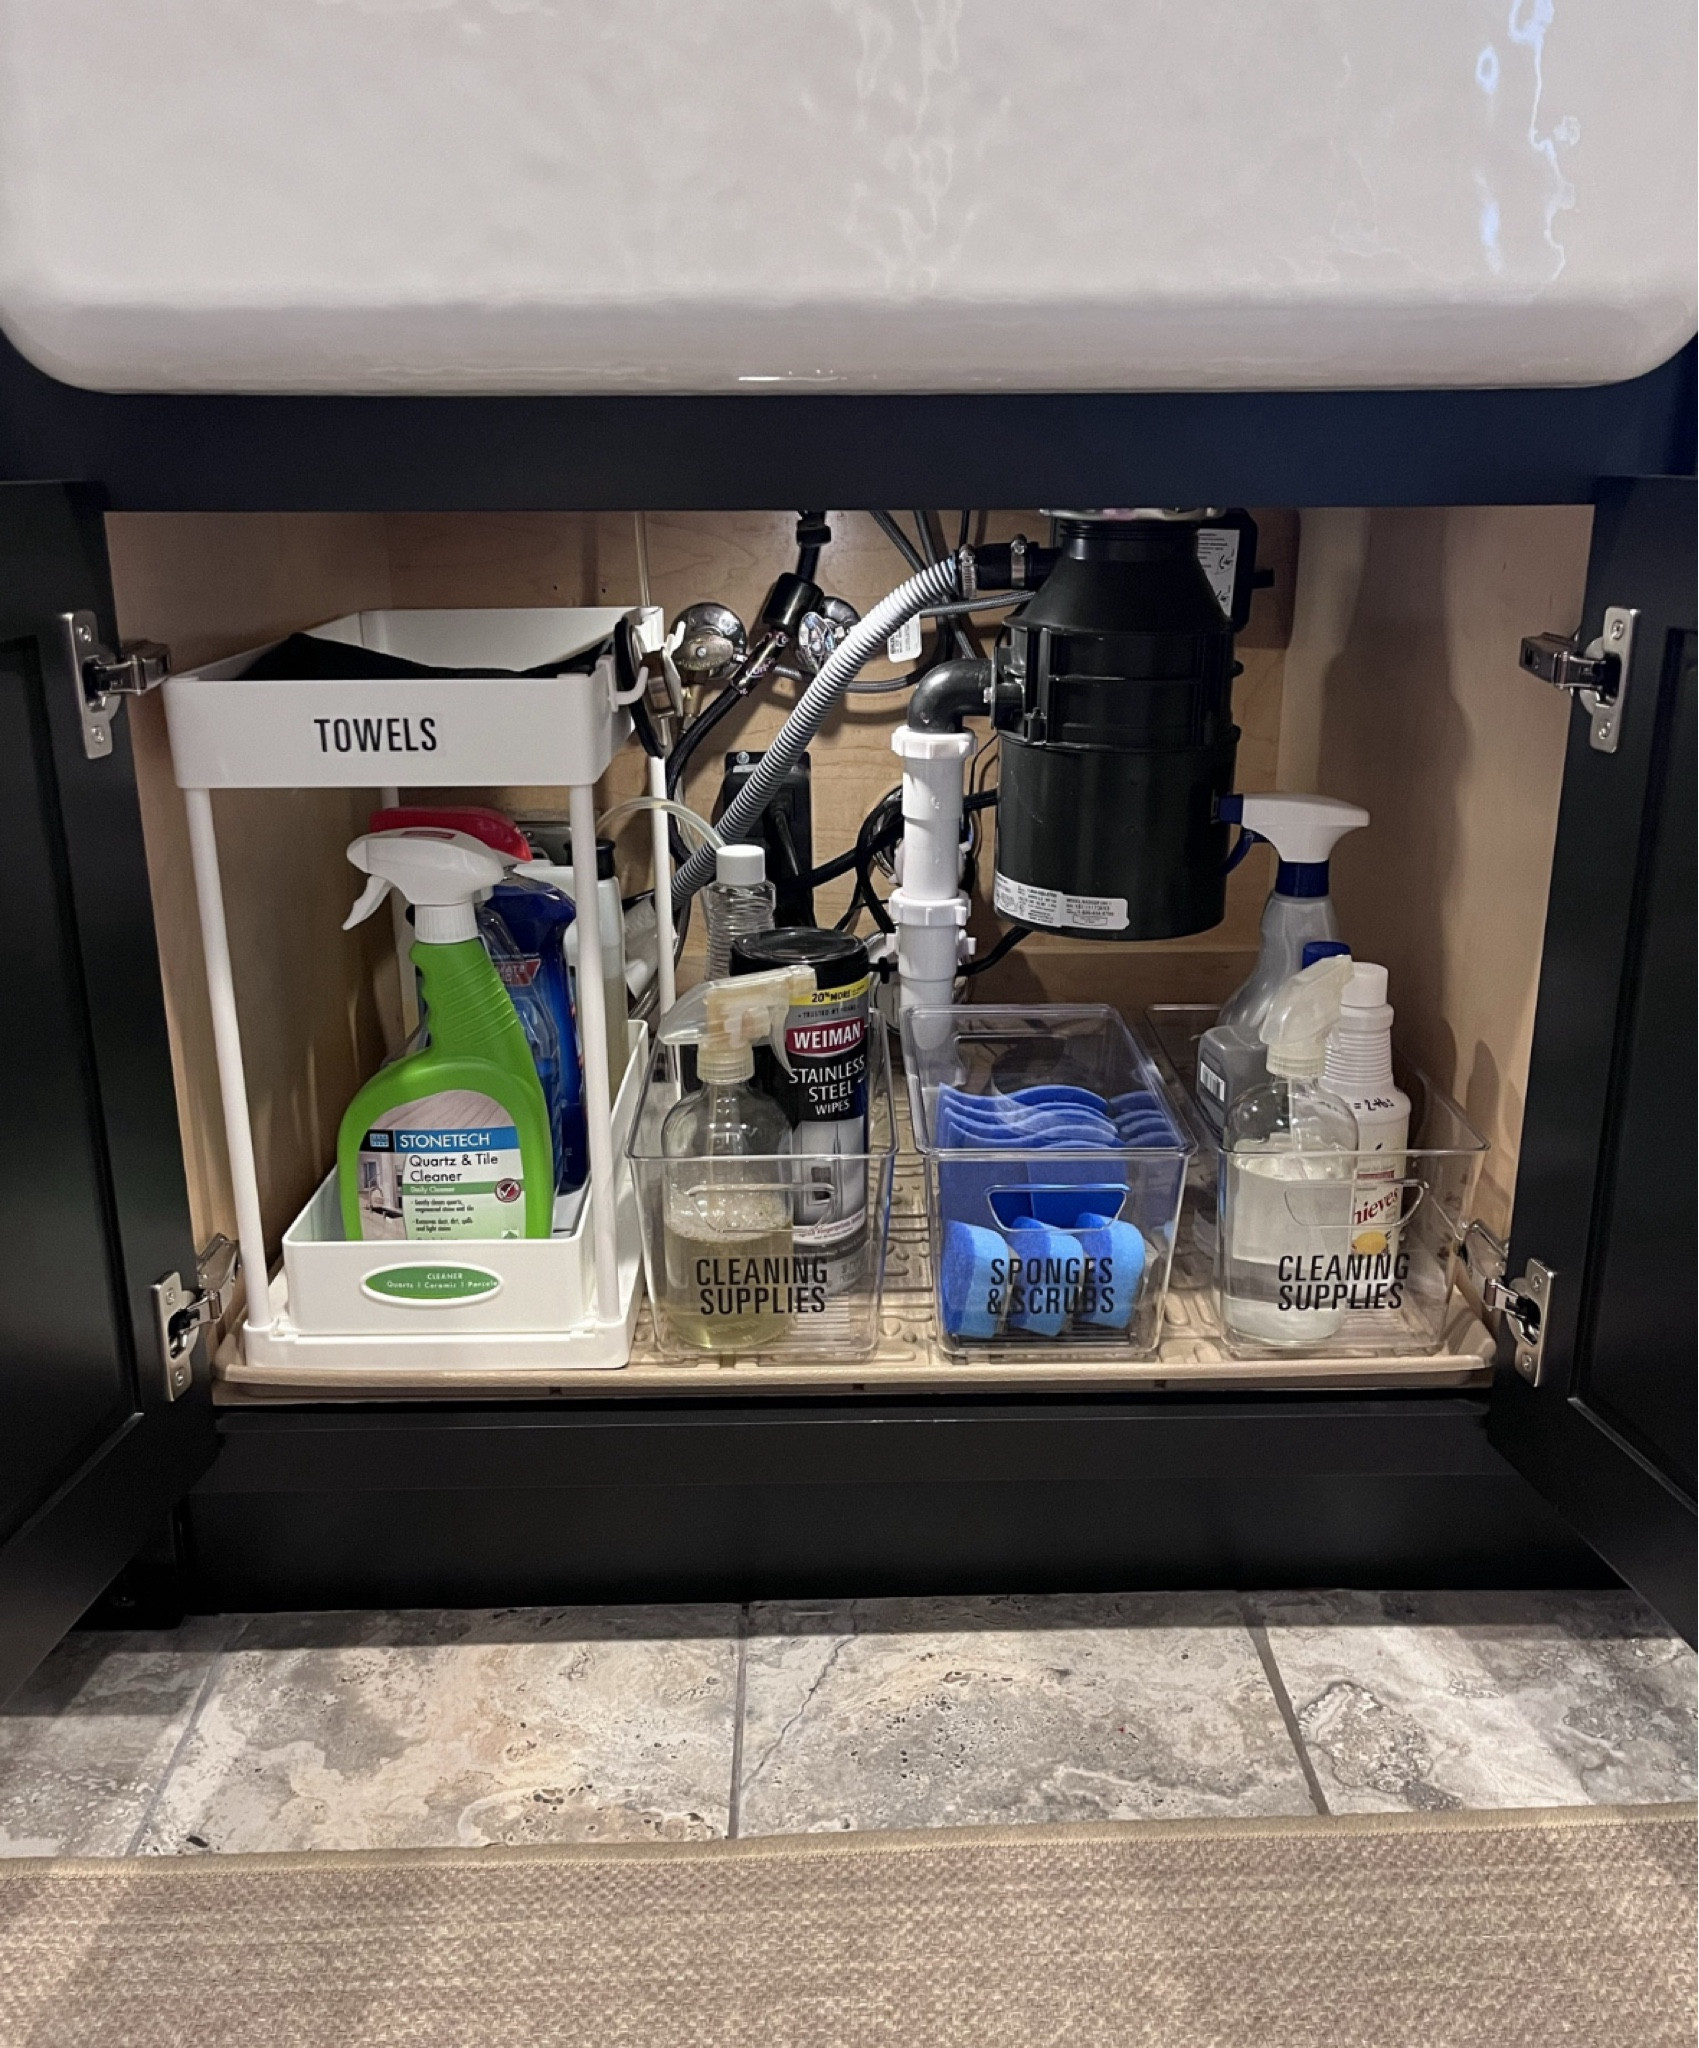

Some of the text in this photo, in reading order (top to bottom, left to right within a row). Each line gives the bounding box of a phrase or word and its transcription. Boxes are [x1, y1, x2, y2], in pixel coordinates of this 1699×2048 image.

[313, 717, 437, 752] TOWELS
[793, 1021, 861, 1049] WEIMAN
[789, 1054, 865, 1084] STAINLESS
[808, 1082, 854, 1102] STEEL
[815, 1099, 850, 1115] WIPES
[400, 1133, 491, 1149] STONETECH
[409, 1152, 499, 1168] Quartz & Tile
[410, 1169, 463, 1182] Cleaner
[696, 1256, 828, 1286] CLEANING
[990, 1258, 1114, 1285] SPONGES
[1278, 1254, 1411, 1282] CLEANING
[700, 1286, 826, 1315] SUPPLIES
[987, 1286, 1115, 1315] & SCRUBS
[1278, 1283, 1403, 1311] SUPPLIES
